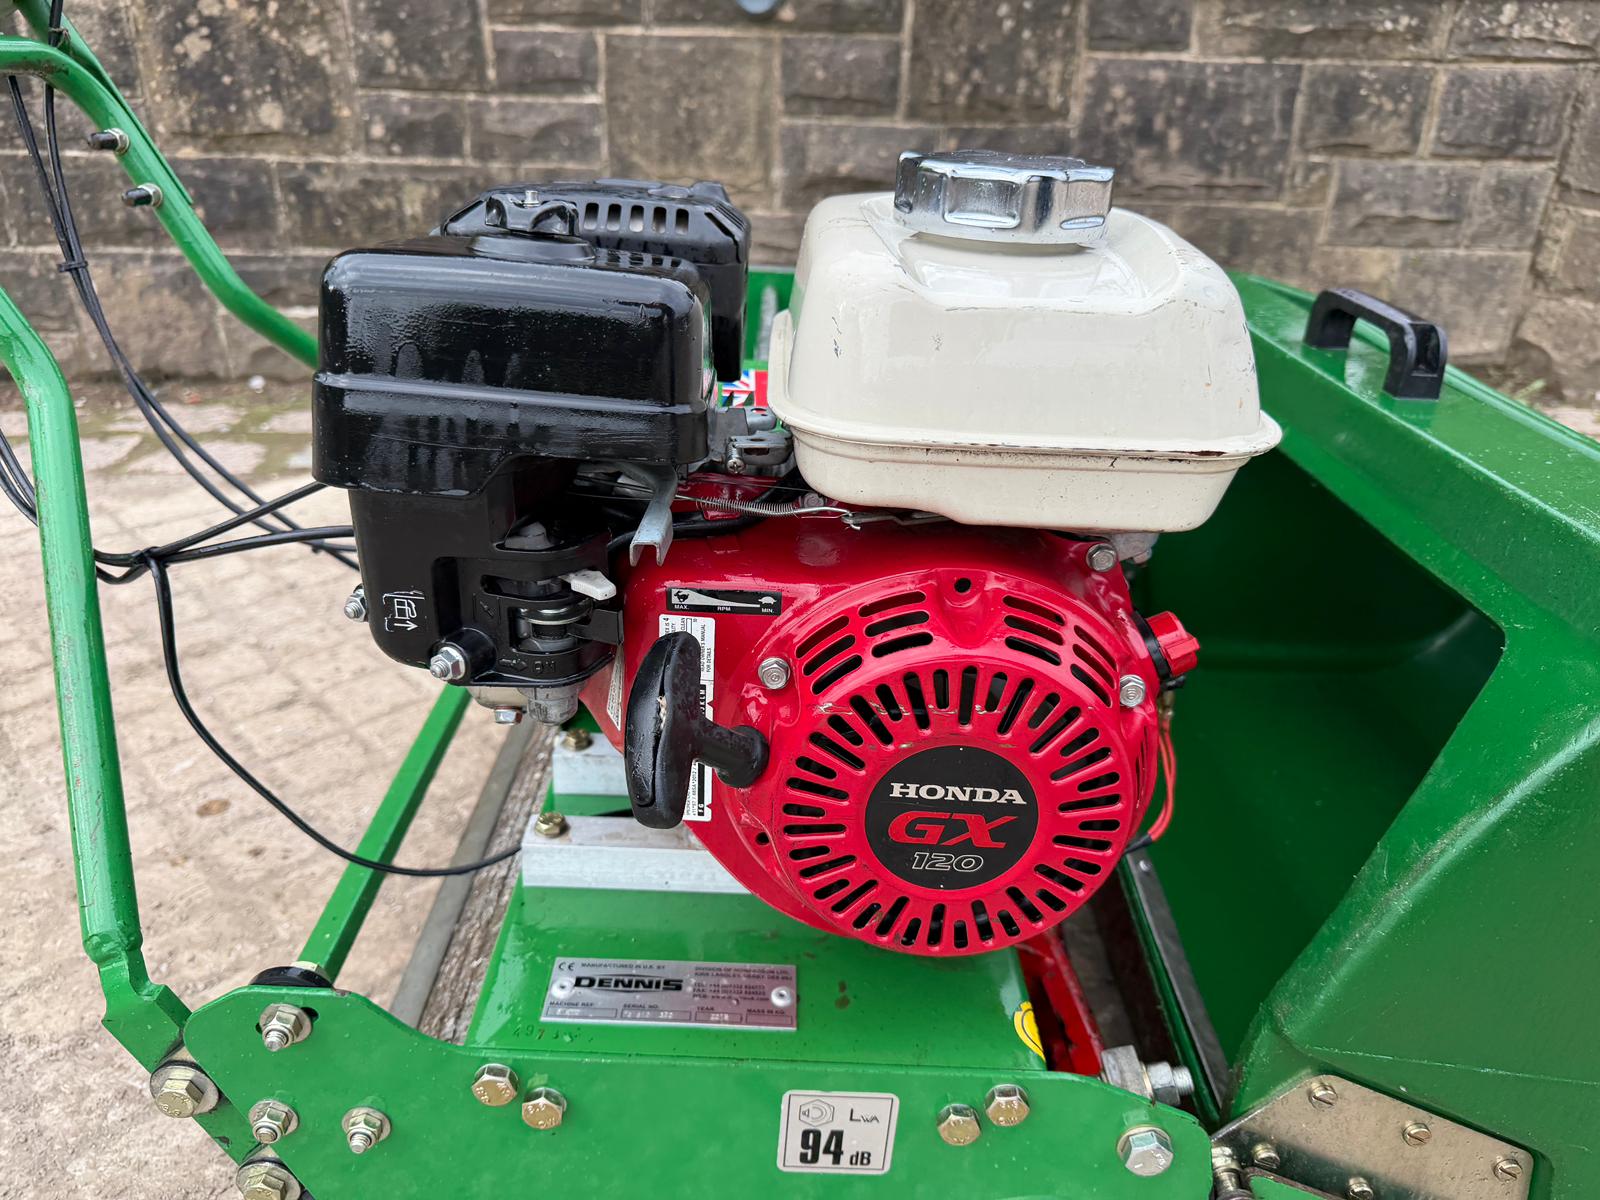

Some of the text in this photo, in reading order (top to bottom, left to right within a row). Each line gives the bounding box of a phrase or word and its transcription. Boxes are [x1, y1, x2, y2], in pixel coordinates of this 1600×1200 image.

[889, 782, 1027, 805] HONDA
[888, 811, 1018, 848] GX
[912, 852, 984, 873] 120
[574, 976, 683, 991] DENNIS
[799, 1129, 872, 1166] 94 dB
